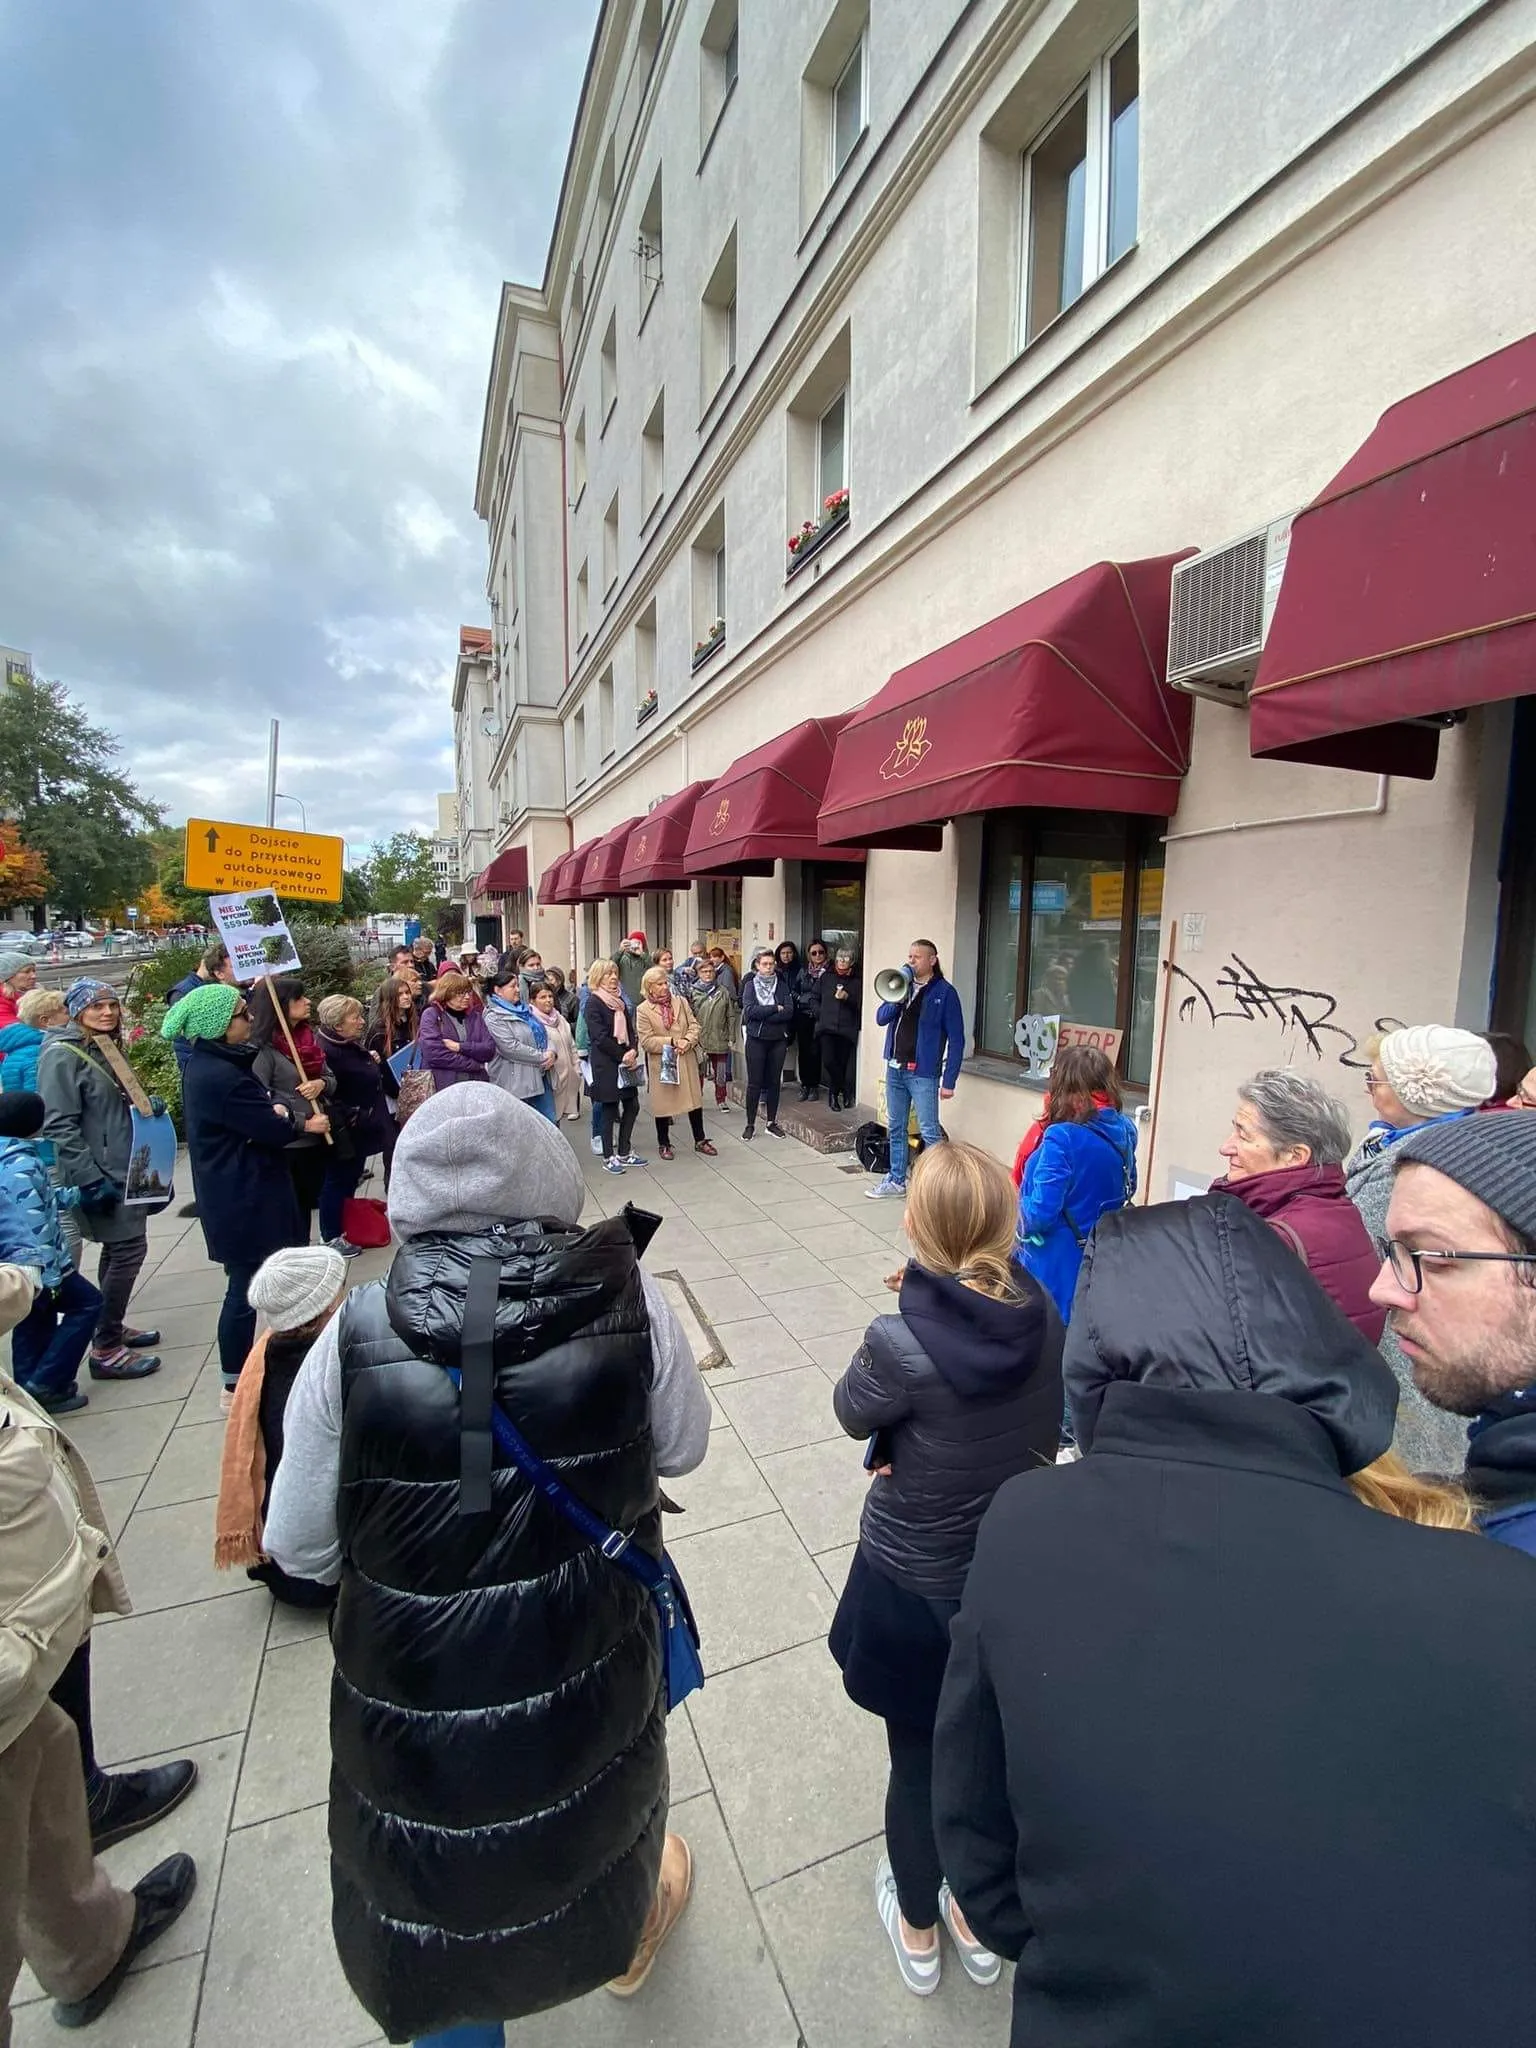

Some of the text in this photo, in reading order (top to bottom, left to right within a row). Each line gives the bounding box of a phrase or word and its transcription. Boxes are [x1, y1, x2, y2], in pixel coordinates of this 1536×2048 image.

[225, 846, 321, 866] do przystanku
[223, 863, 321, 881] autobusowego
[216, 877, 225, 885] w
[271, 880, 328, 895] Centrum
[218, 905, 234, 914] NIE
[220, 911, 251, 920] WYCINKI
[224, 919, 242, 929] 559
[235, 943, 249, 953] NIE
[236, 950, 266, 960] WYCINKI
[239, 958, 256, 968] 559
[1058, 1028, 1115, 1053] STOP
